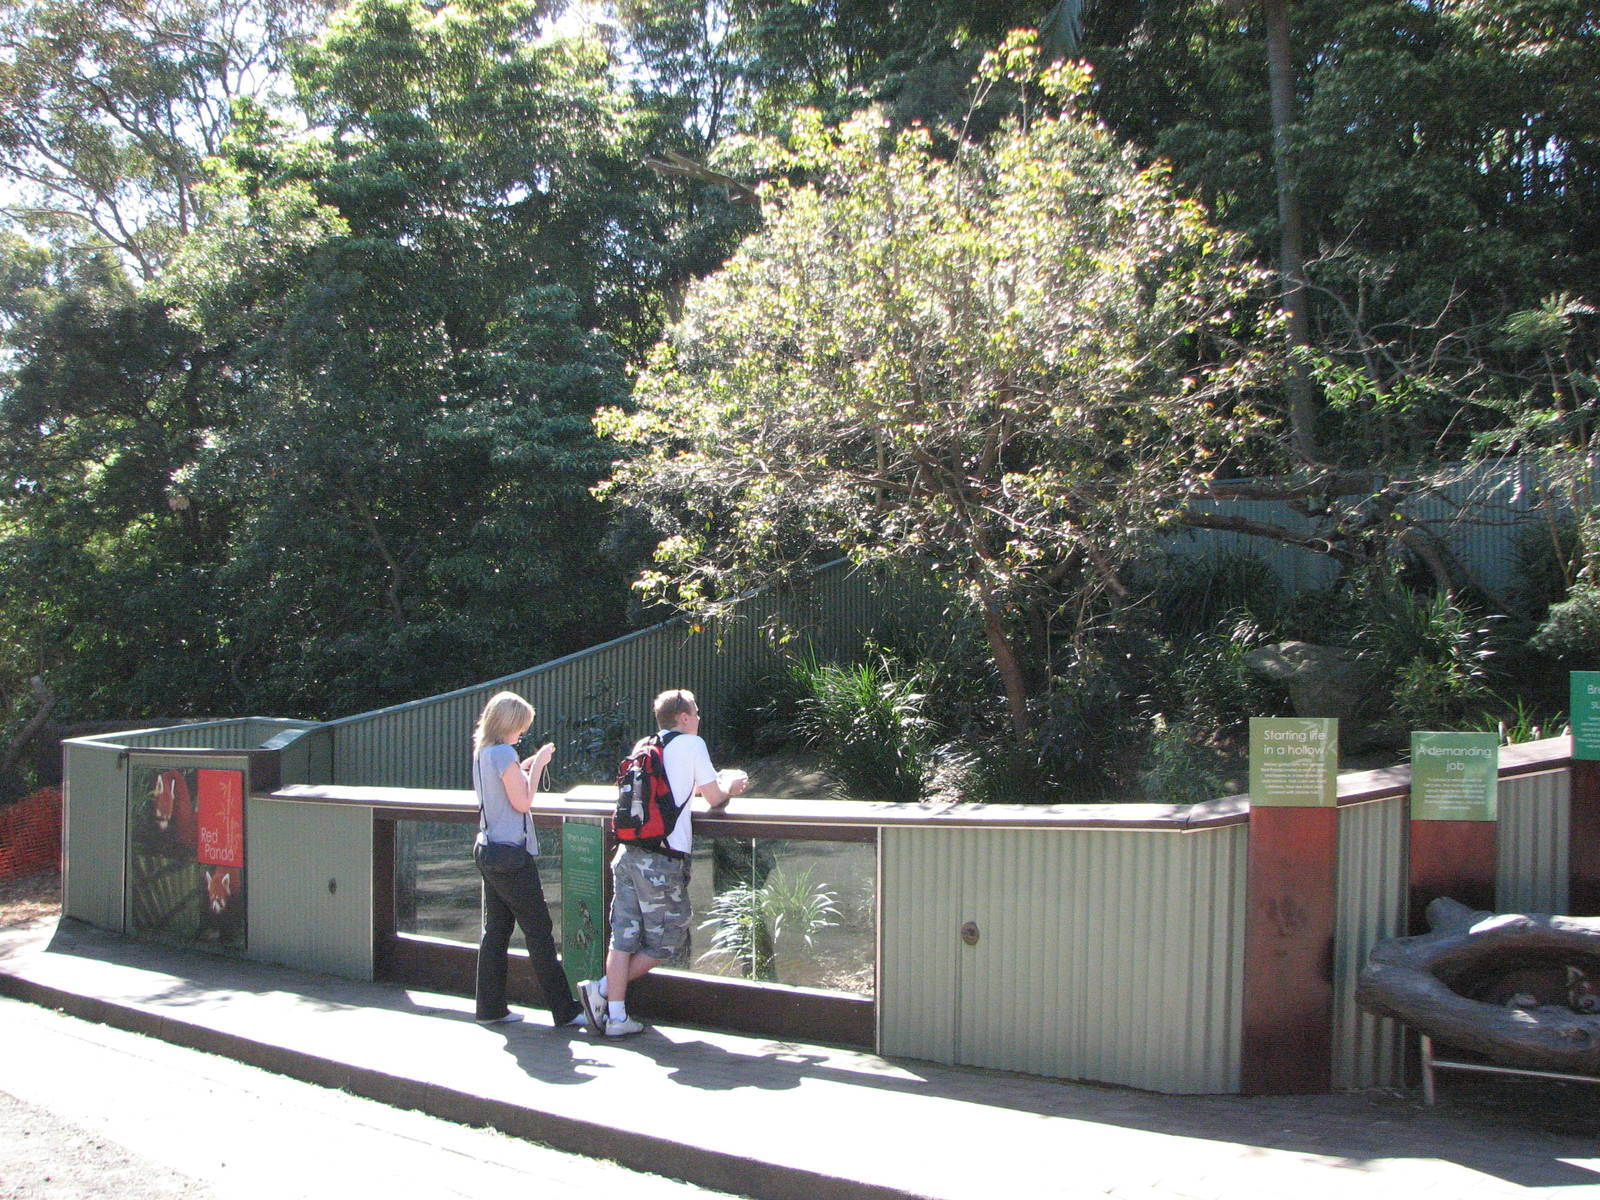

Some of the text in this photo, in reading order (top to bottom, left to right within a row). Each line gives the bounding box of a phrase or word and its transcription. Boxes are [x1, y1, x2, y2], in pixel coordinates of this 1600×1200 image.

[1264, 730, 1328, 743] Starting life
[1264, 744, 1325, 756] in a hollow
[1428, 746, 1492, 759] demanding
[1446, 760, 1465, 773] job
[201, 827, 218, 844] Red
[205, 843, 234, 861] Panda
